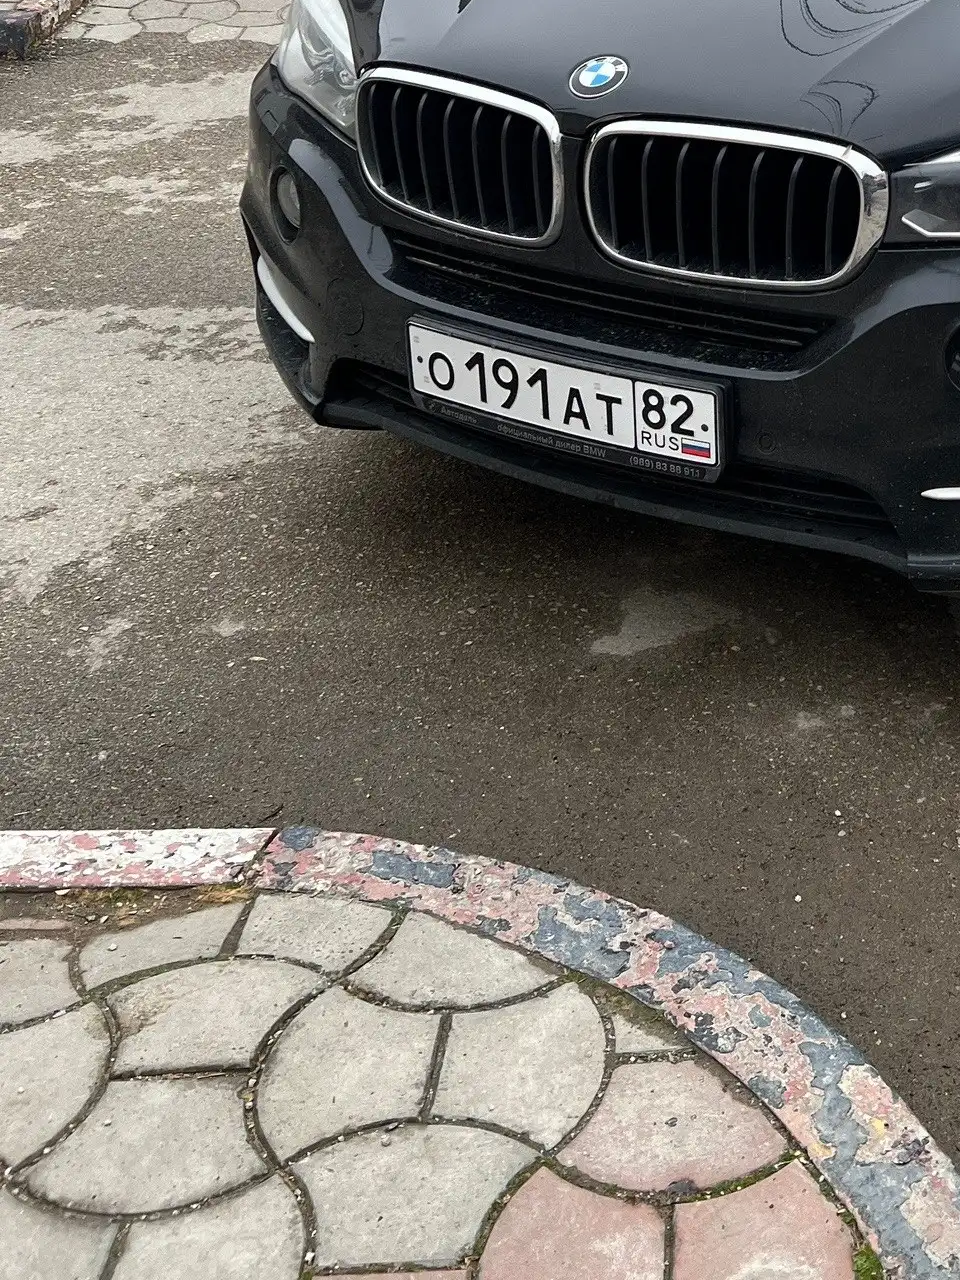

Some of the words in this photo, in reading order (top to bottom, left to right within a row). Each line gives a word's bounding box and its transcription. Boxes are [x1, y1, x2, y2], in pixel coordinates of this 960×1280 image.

[642, 388, 695, 437] 82
[583, 443, 607, 458] BMW
[641, 430, 679, 452] RUS
